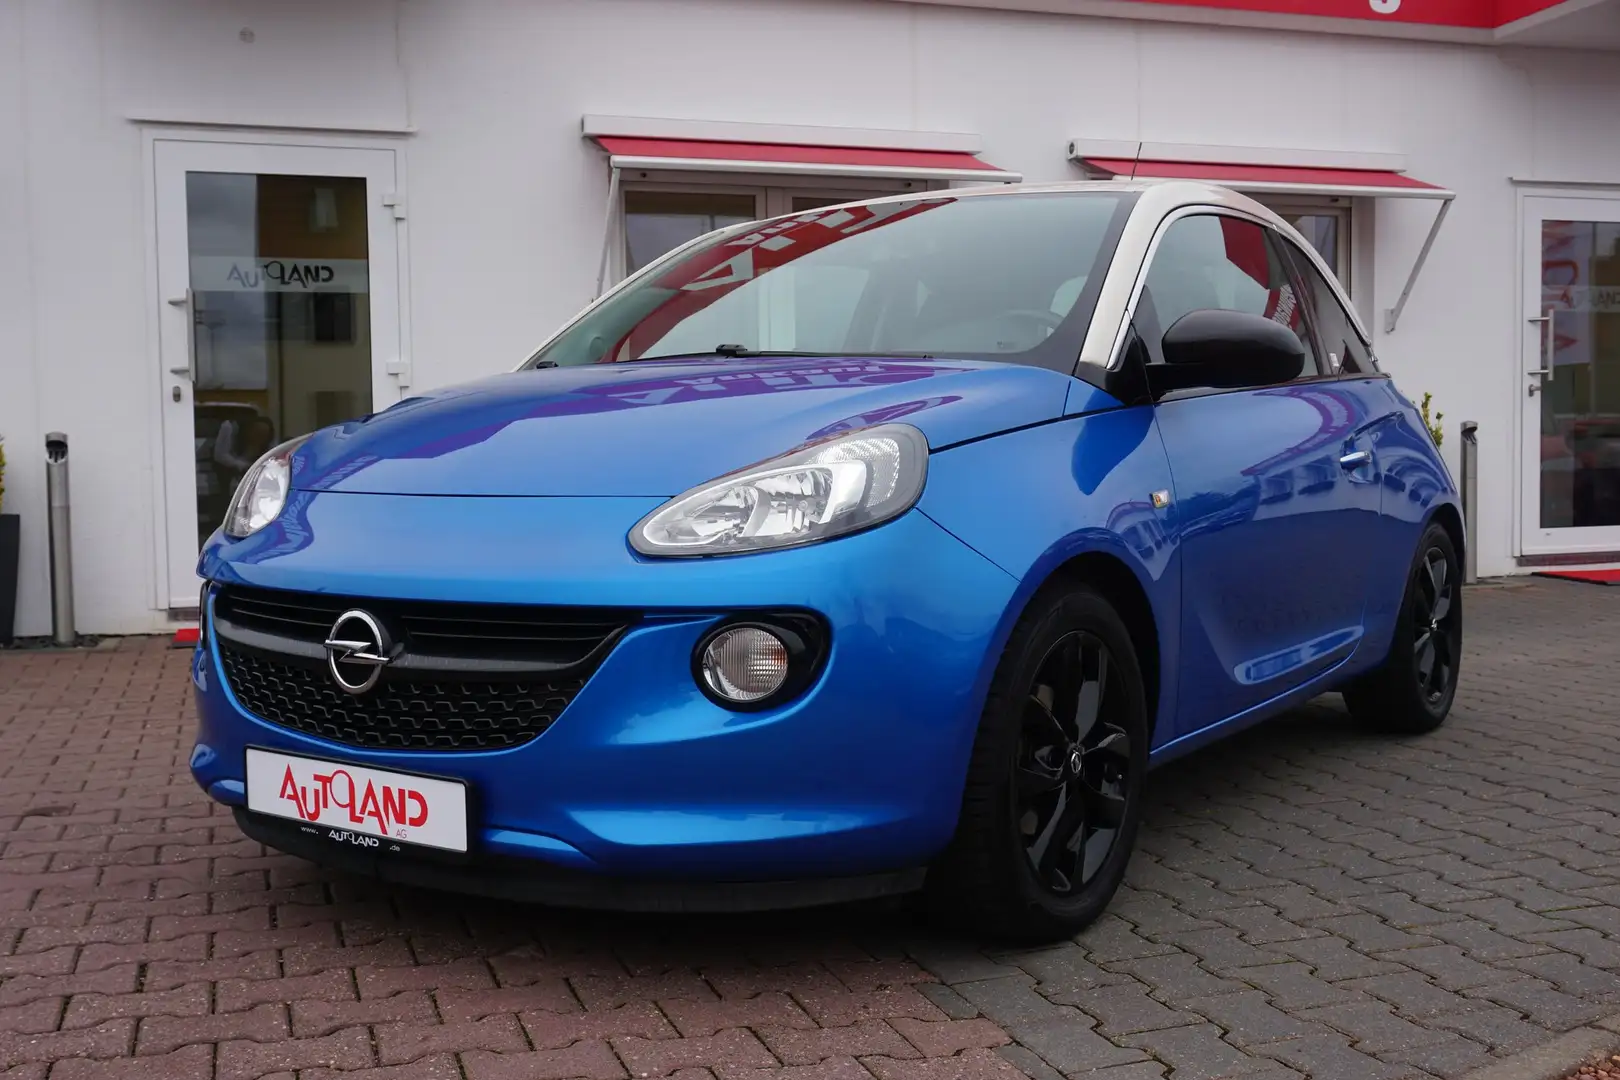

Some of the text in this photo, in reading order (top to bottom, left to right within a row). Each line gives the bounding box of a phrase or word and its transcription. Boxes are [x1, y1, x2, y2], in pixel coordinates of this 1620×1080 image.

[227, 261, 334, 288] AUTOLAND
[279, 763, 429, 835] AUTOLAND
[328, 829, 379, 847] AUTOLAND
[396, 829, 407, 839] AG
